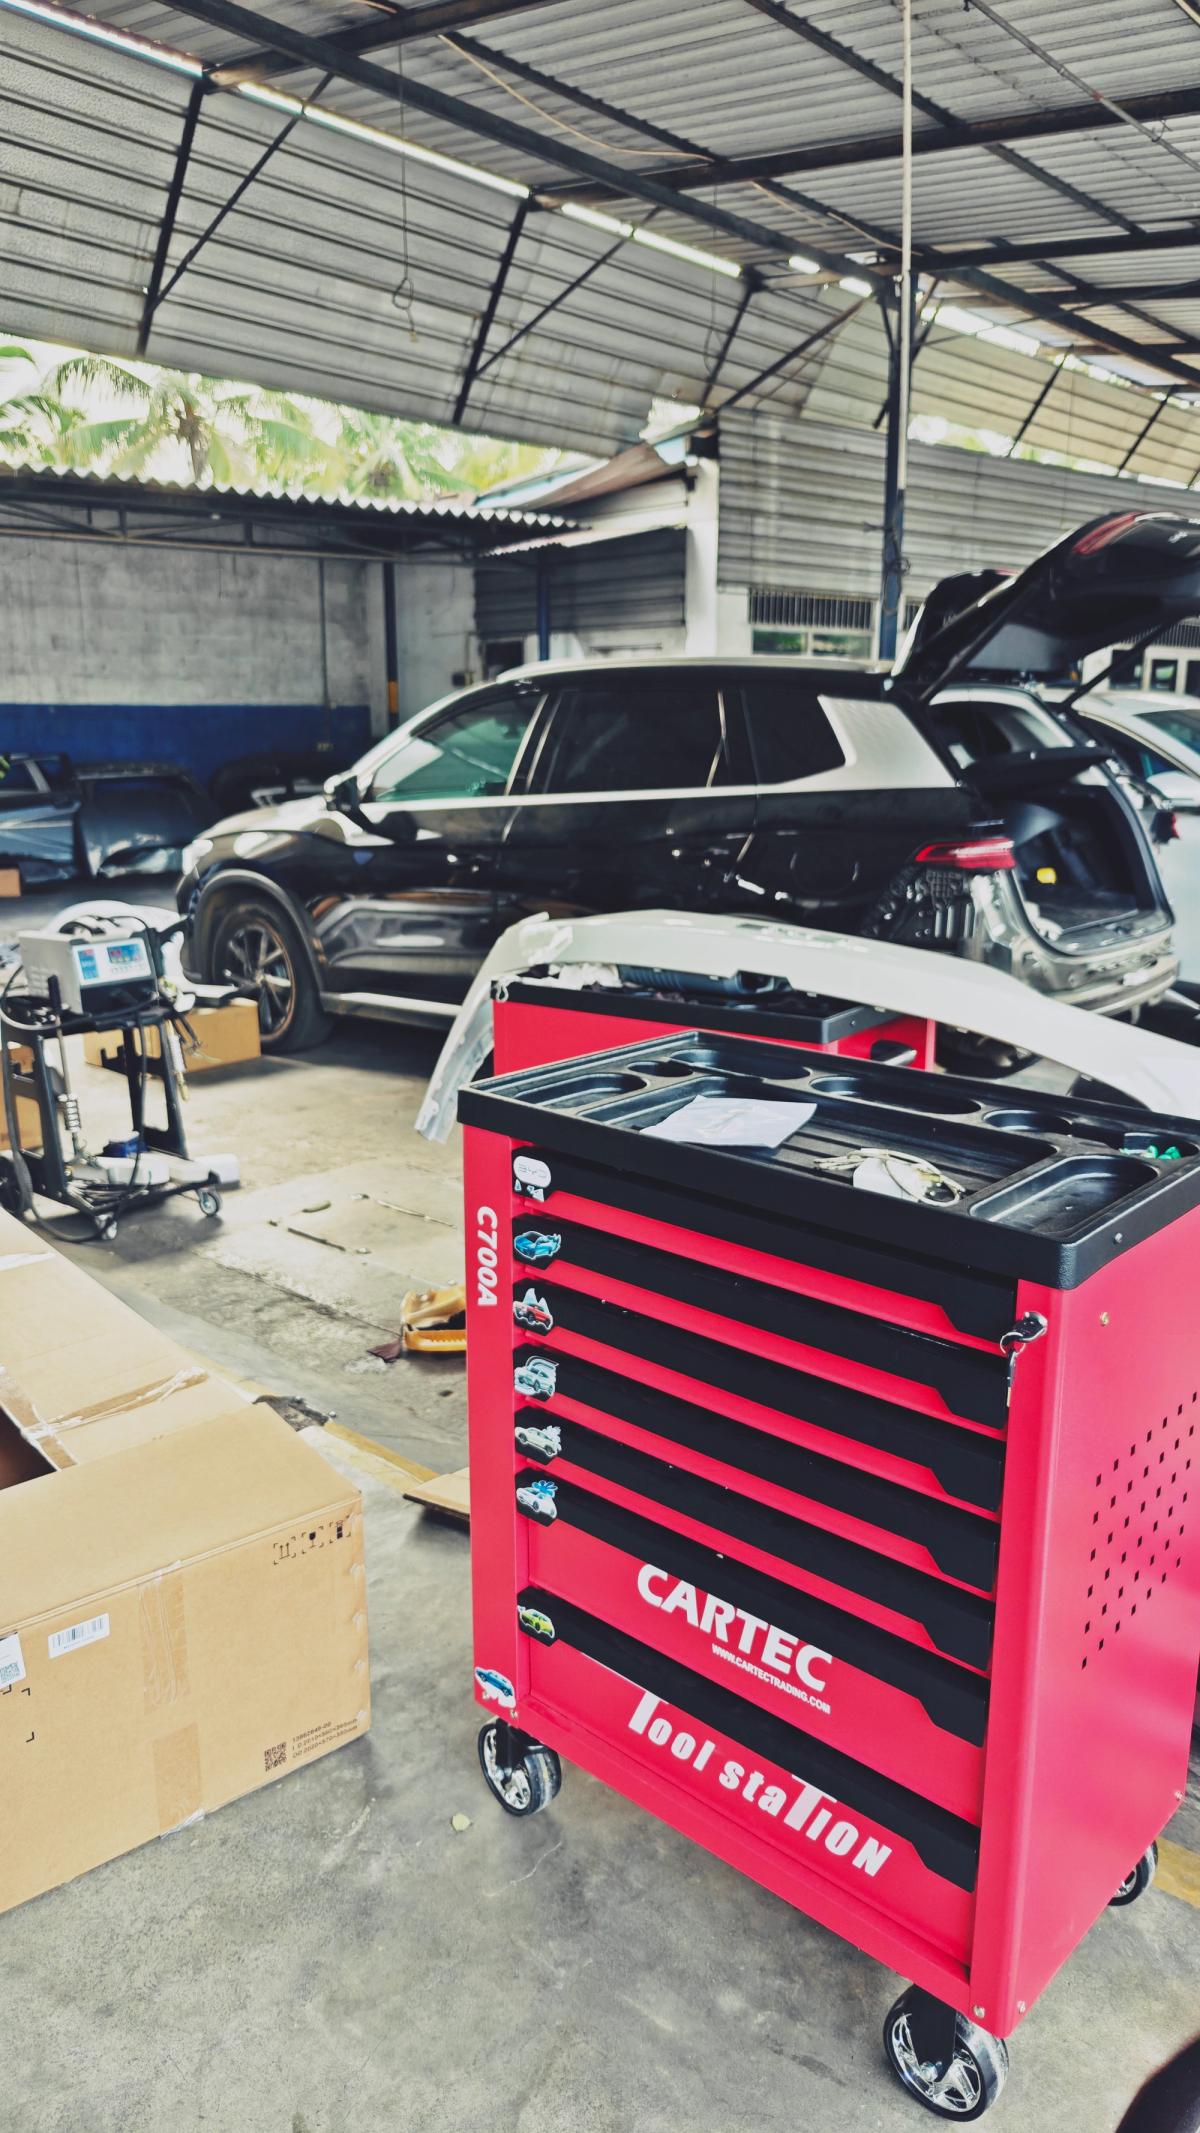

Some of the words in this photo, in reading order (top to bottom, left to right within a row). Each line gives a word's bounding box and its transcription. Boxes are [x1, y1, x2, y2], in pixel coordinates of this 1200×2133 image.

[477, 1206, 498, 1306] C700A
[637, 1563, 832, 1692] CARTEC
[711, 1643, 831, 1715] WWW.CARTECTRADING.COM
